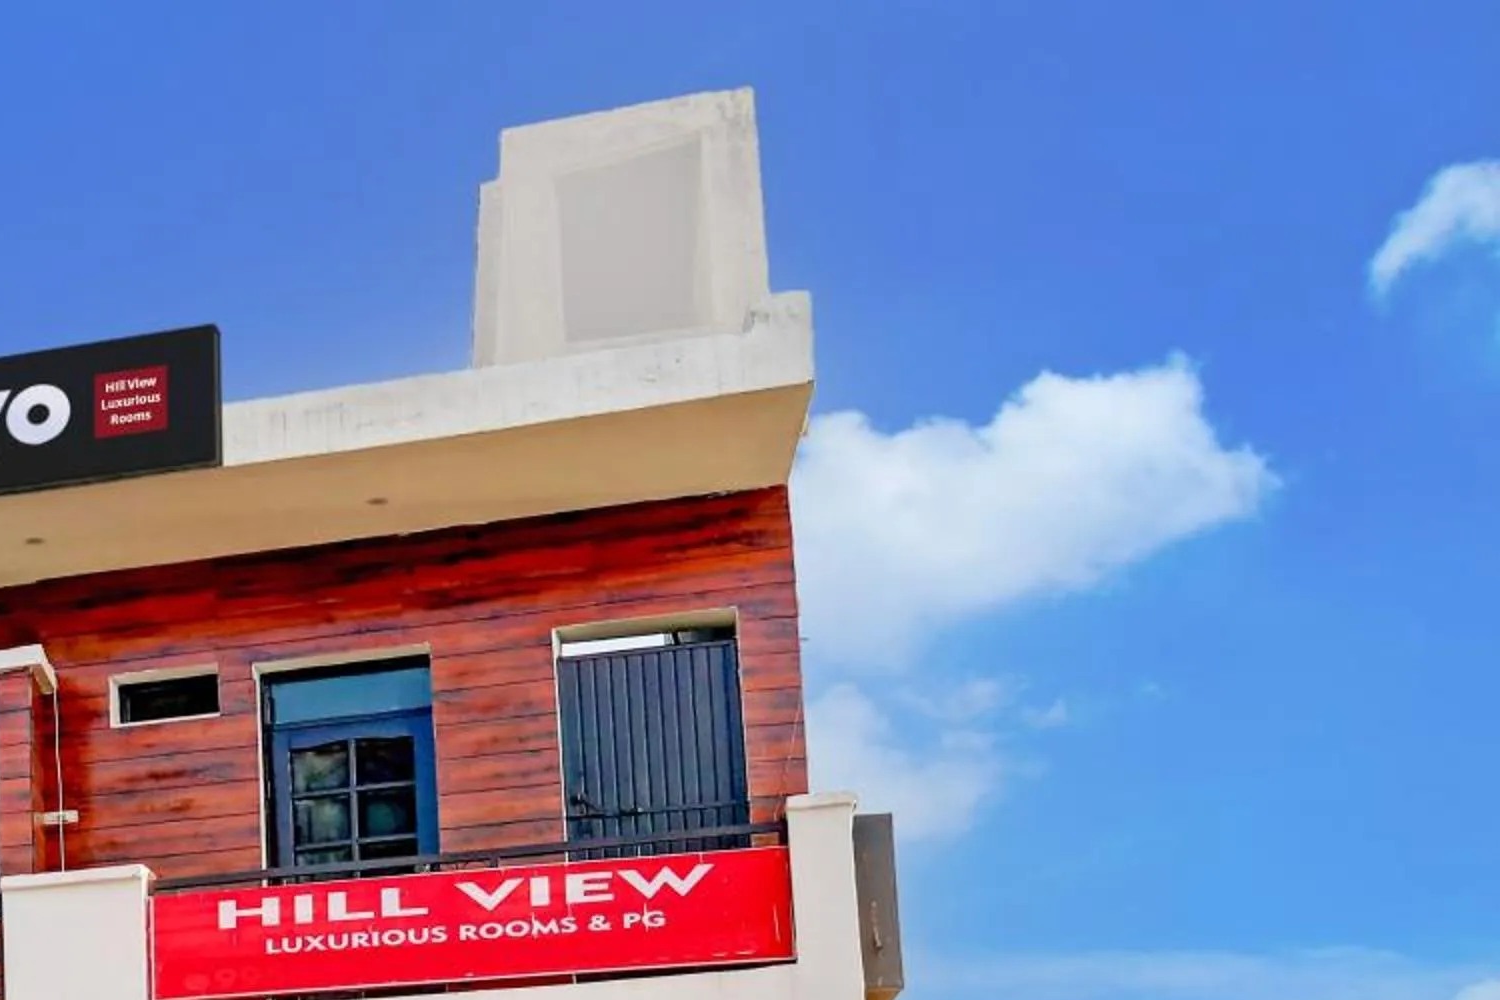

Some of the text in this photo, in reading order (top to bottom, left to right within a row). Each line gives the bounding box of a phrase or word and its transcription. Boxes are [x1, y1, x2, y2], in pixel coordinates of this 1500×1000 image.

[105, 377, 157, 393] Hill View
[101, 393, 161, 411] Luxurious
[110, 411, 152, 425] Rooms
[217, 863, 716, 930] HILL VIEW
[265, 910, 667, 955] LUXURIOUS ROOMS & PG
